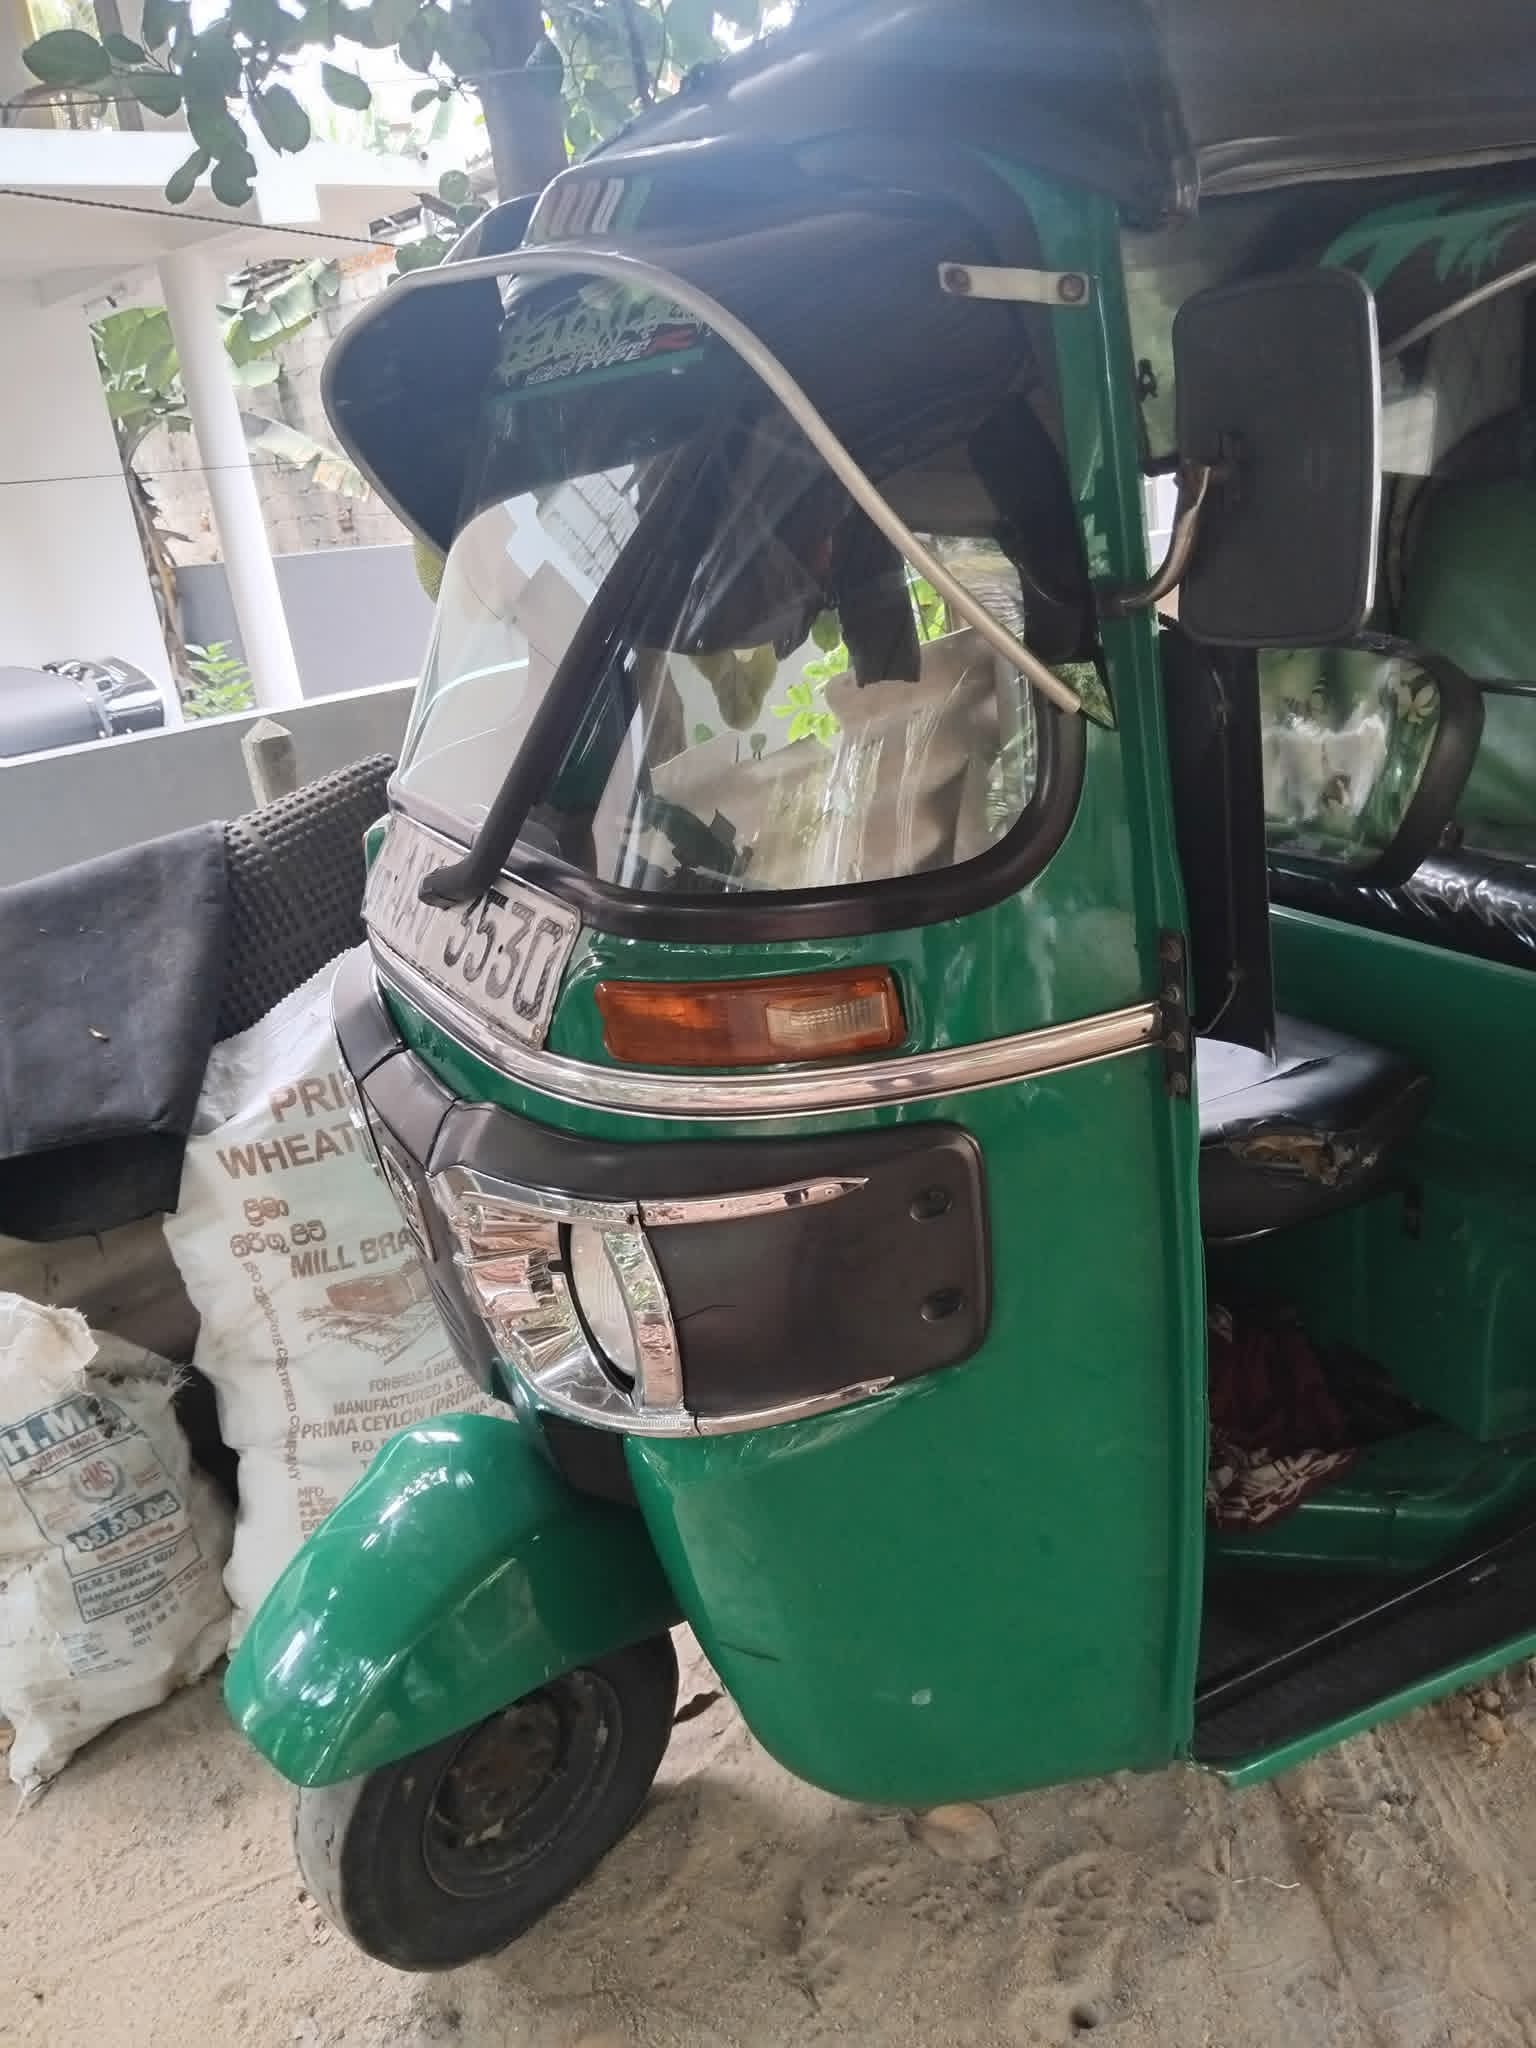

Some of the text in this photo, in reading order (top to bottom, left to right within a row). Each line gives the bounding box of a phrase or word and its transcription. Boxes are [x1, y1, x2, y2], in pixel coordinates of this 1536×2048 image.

[269, 1070, 351, 1122] PRI
[216, 1120, 355, 1180] WHEAT
[290, 1226, 416, 1279] MILL BRA
[302, 1418, 358, 1439] PRIMA
[362, 1405, 425, 1433] CEYLON
[430, 1383, 480, 1414] (PRIVA
[333, 1381, 441, 1416] MANUFACTURED
[1, 1396, 100, 1465] H.M.
